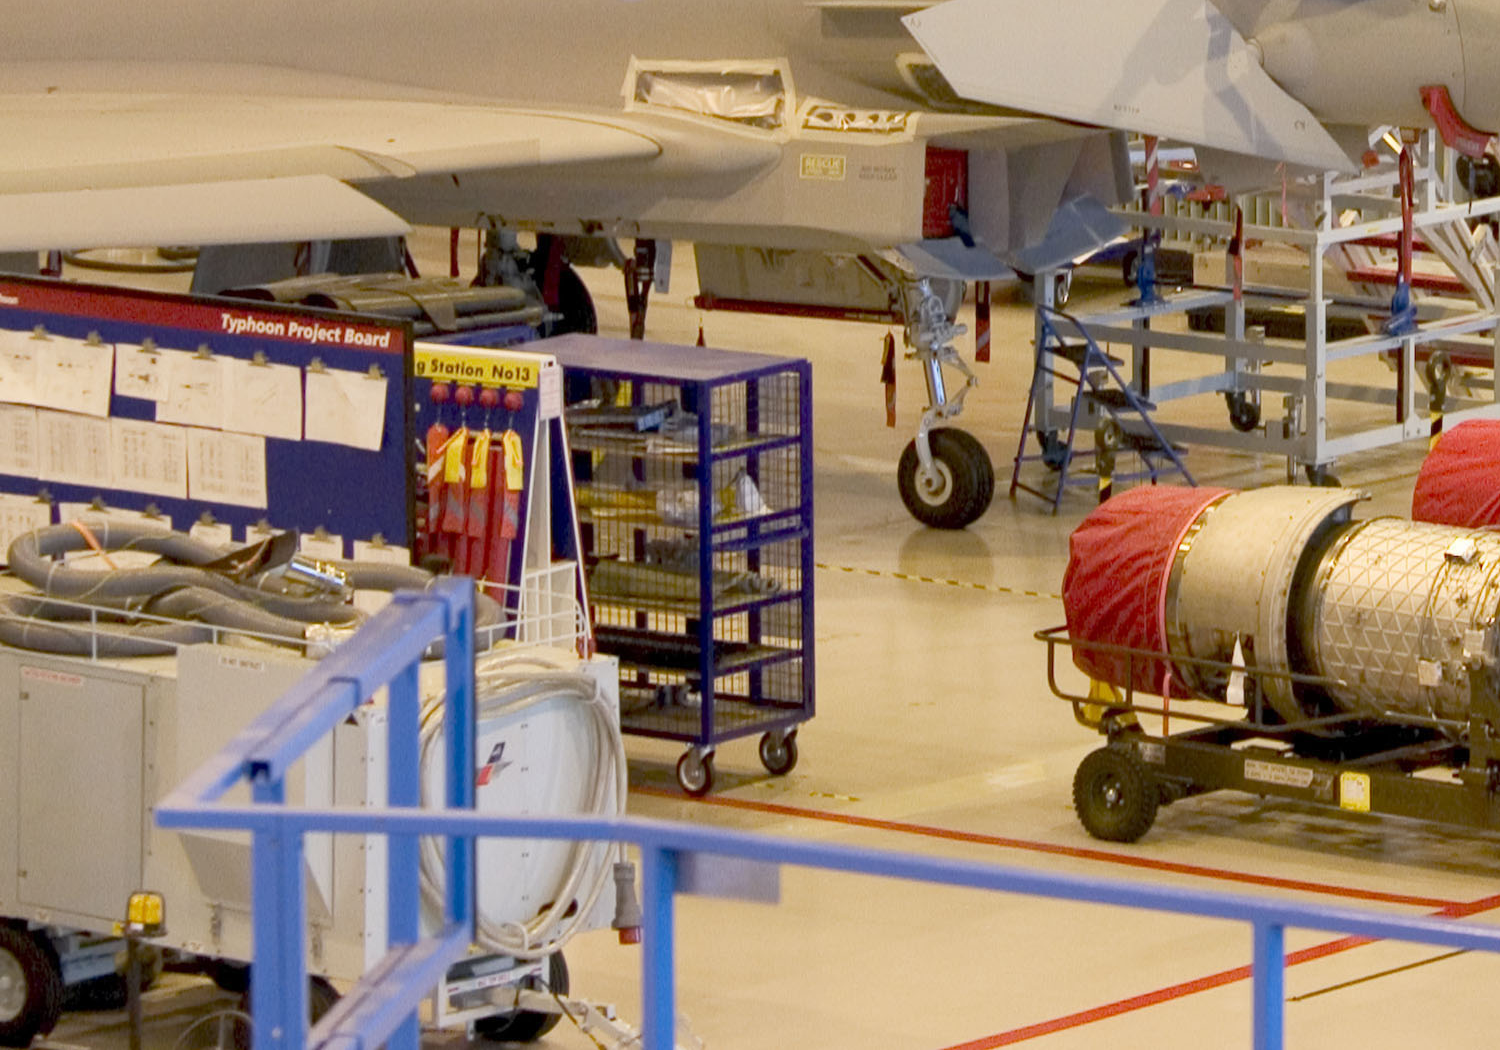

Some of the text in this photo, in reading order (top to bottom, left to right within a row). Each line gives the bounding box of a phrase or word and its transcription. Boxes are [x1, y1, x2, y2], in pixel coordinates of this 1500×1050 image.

[221, 313, 391, 347] Typhoon Project Board
[430, 358, 483, 378] Station
[492, 363, 530, 382] No13
